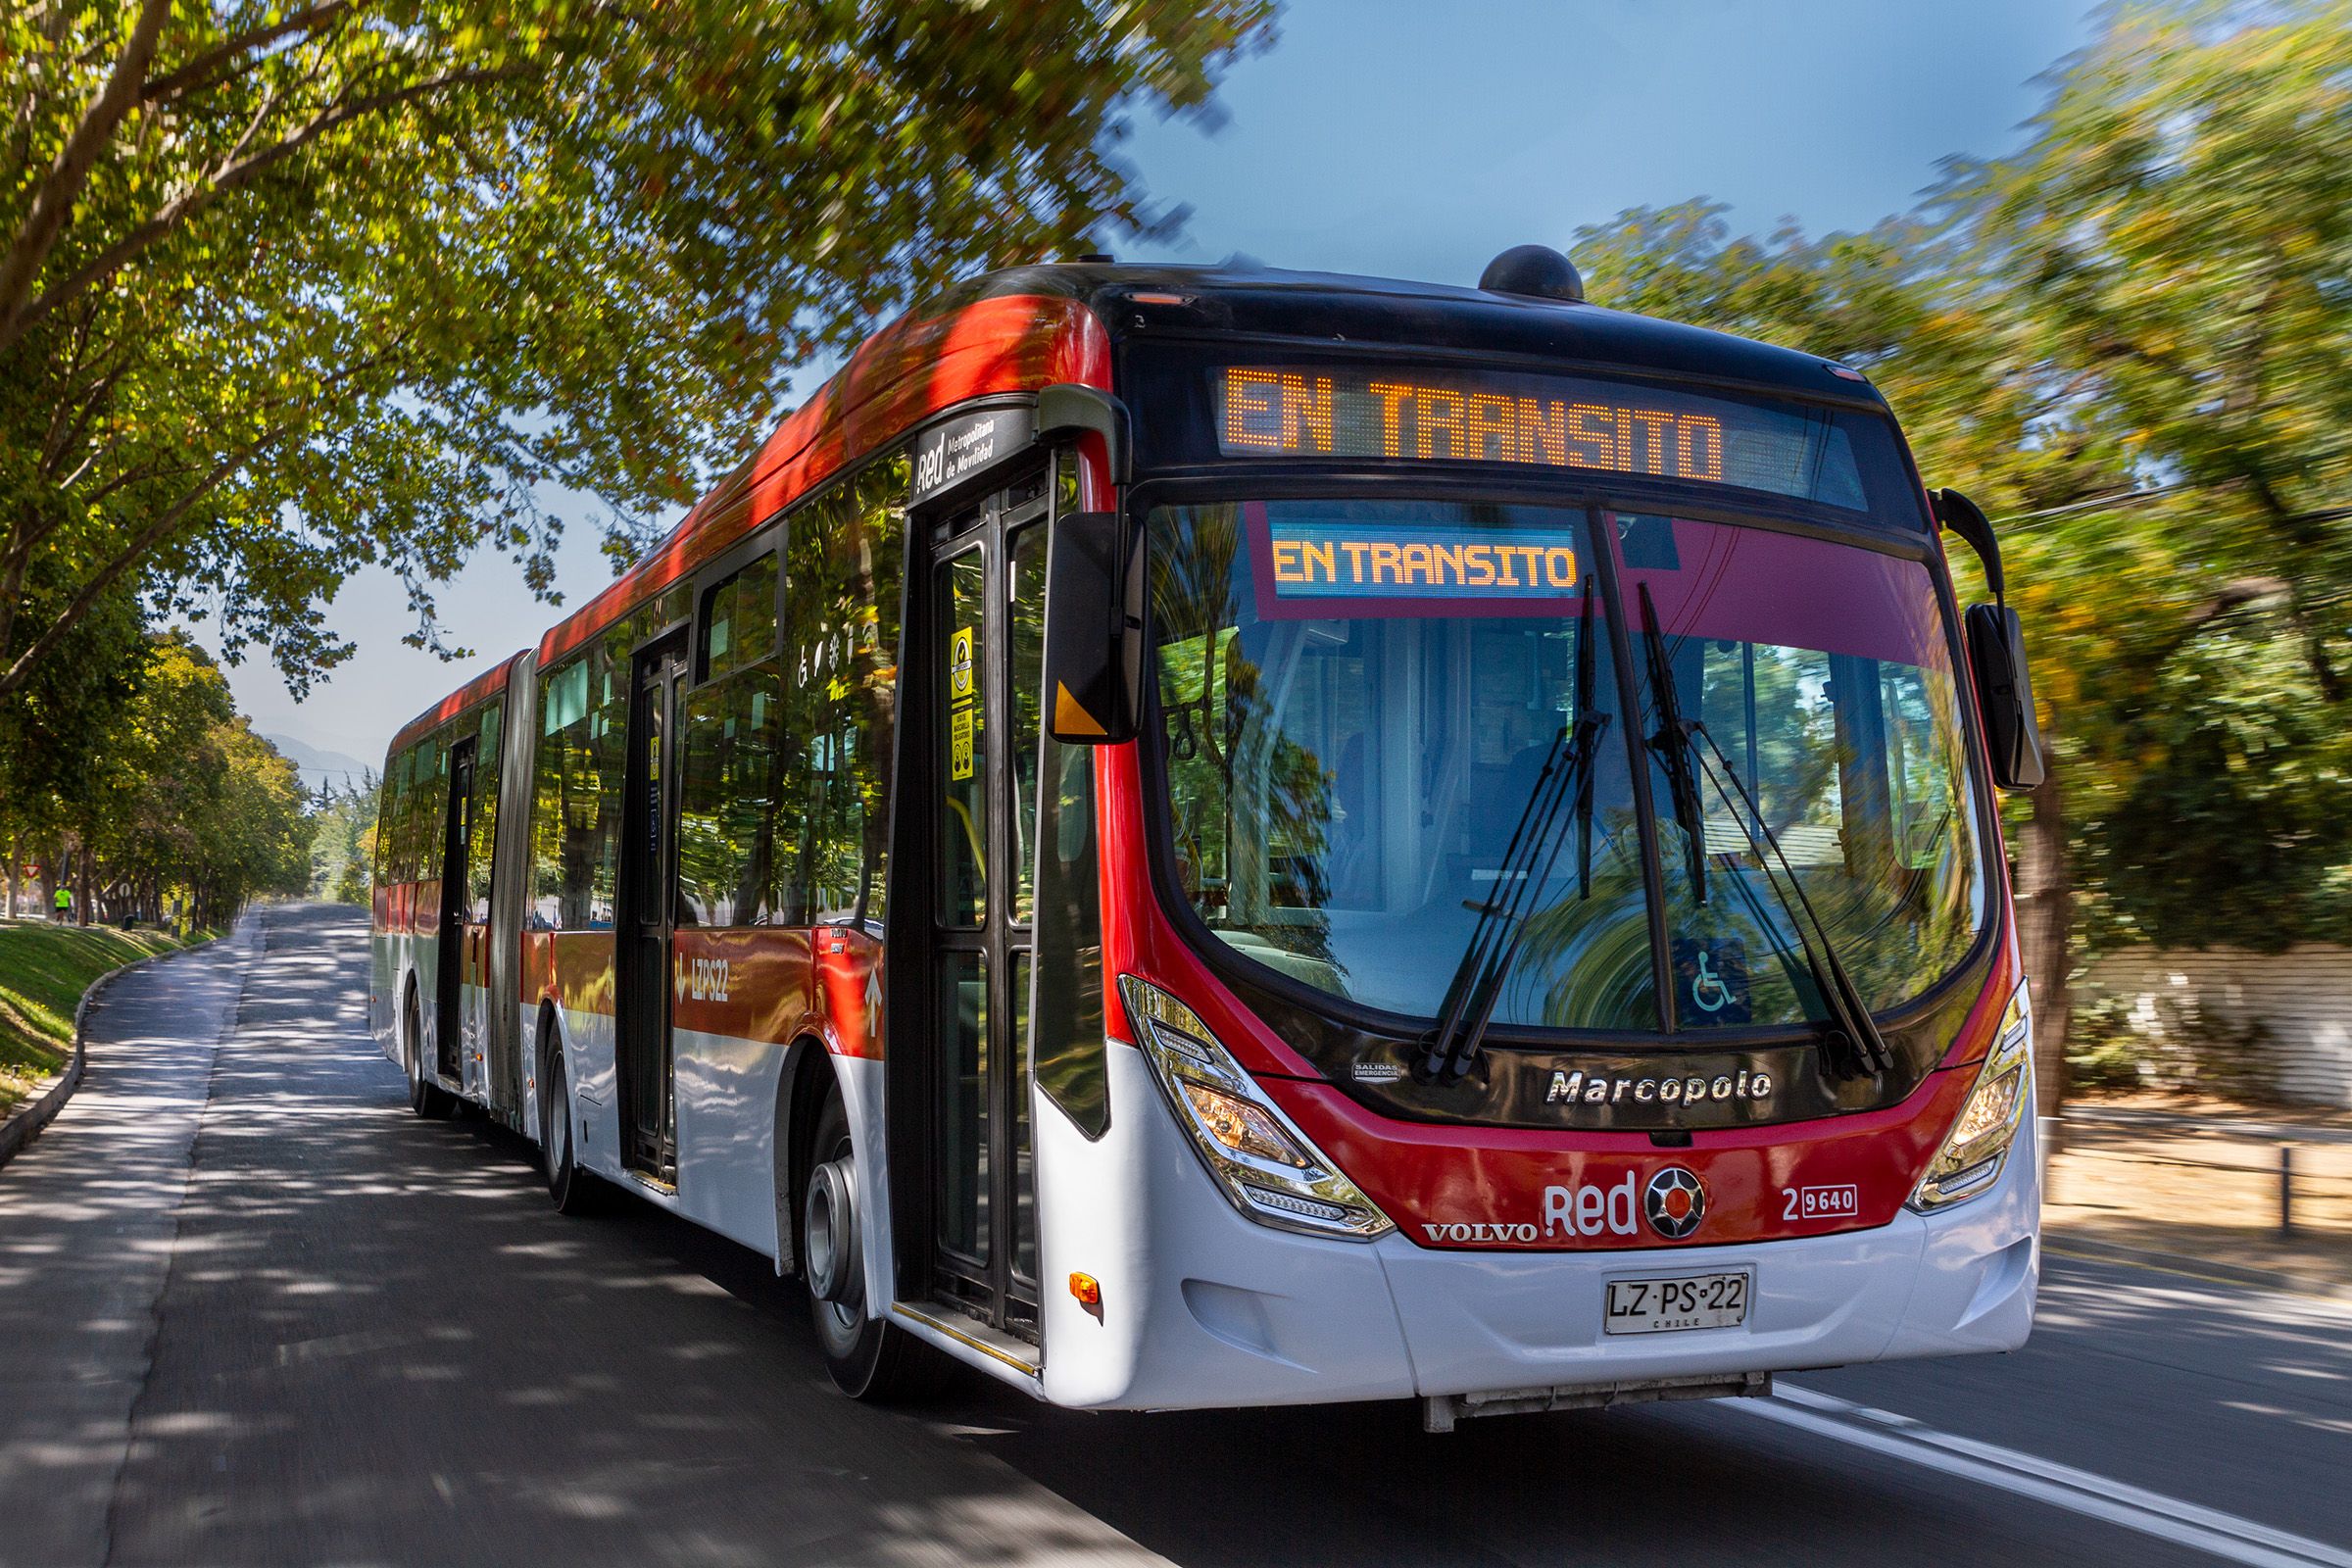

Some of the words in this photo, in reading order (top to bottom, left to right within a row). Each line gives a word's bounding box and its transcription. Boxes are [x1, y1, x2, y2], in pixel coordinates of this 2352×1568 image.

[948, 419, 995, 456] Metropolitana
[1227, 368, 1333, 452] EN
[1370, 383, 1722, 481] TRANSITO
[916, 432, 946, 494] Red
[946, 461, 956, 479] de
[956, 439, 994, 474] Movilidad
[1273, 541, 1336, 583] EN
[1341, 542, 1577, 588] TRANSITO
[691, 958, 728, 1003] LZPS22
[1546, 1070, 1772, 1107] Marcopolo
[1544, 1170, 1639, 1237] Red
[1782, 1188, 1798, 1221] 2
[1805, 1190, 1853, 1212] 9640
[1421, 1223, 1538, 1243] VOLVO
[1653, 1317, 1700, 1329] CHILE
